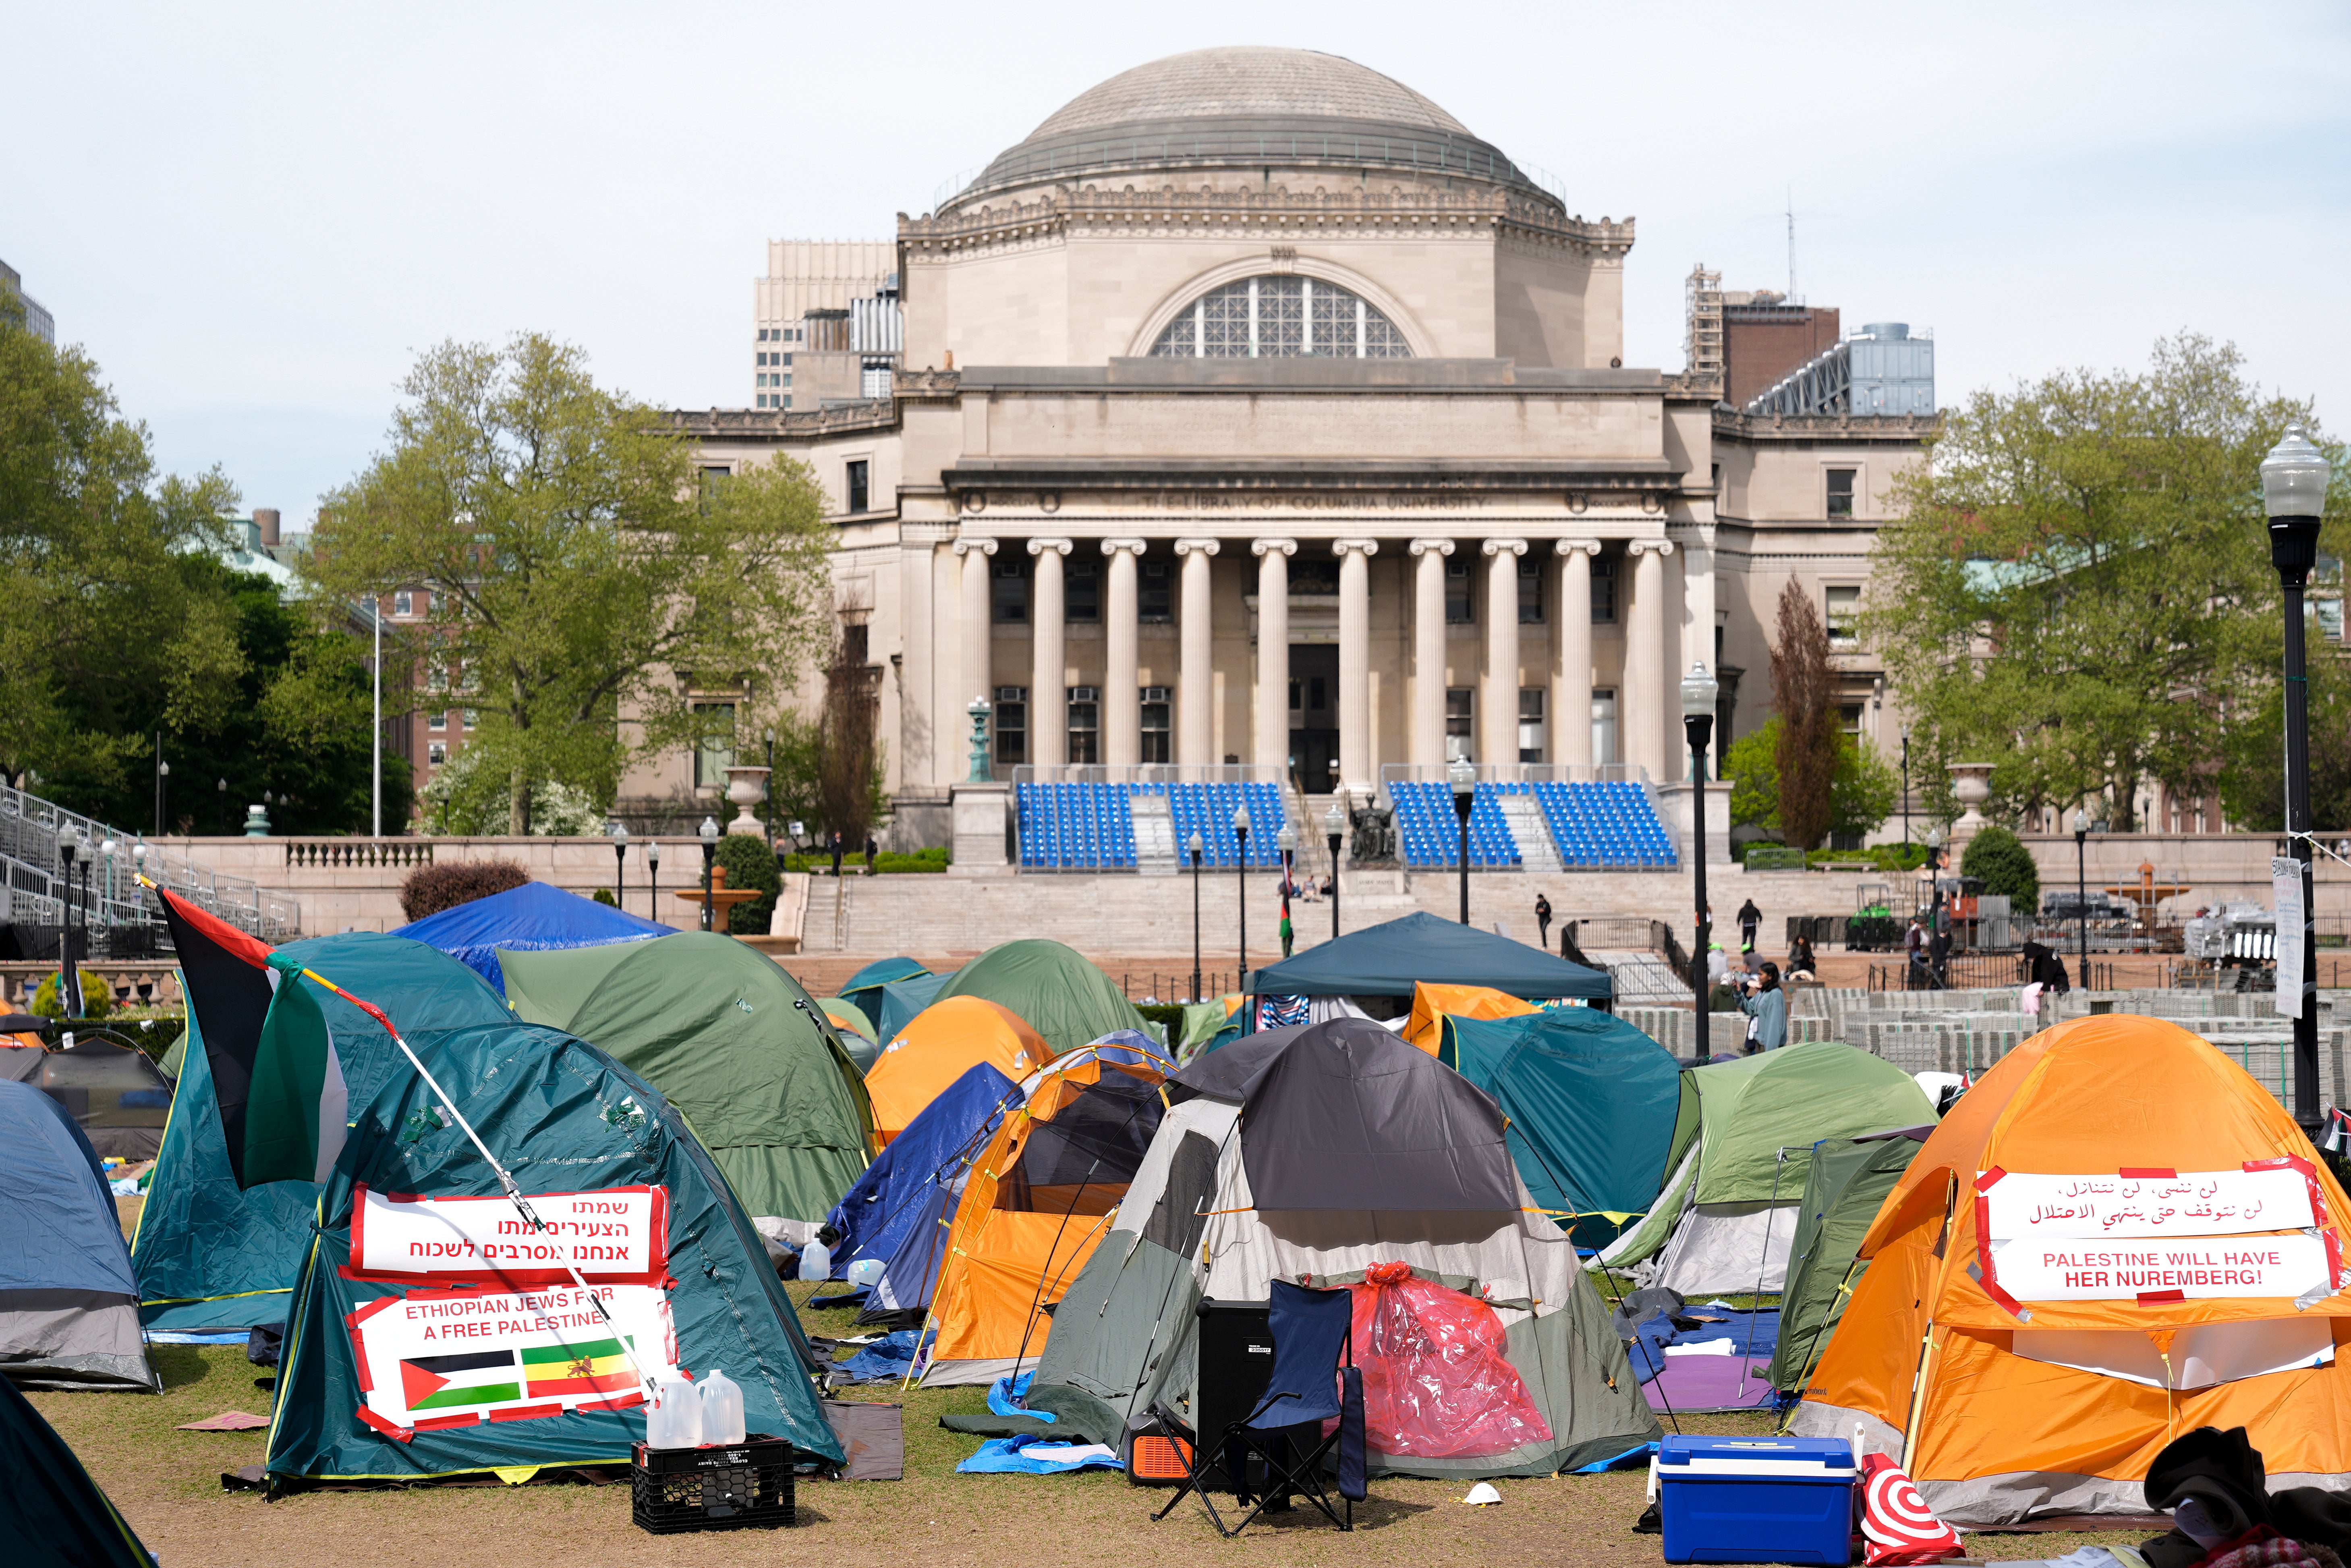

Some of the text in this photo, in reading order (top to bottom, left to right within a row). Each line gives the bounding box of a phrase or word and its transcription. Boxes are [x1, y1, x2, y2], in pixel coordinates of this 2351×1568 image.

[1142, 495, 1174, 509] THE
[1259, 495, 1283, 509] OF
[1290, 495, 1377, 509] COLUMBIA
[1386, 495, 1488, 509] UNIVERSITY
[2272, 860, 2300, 878] STAYING FOCUSED
[2123, 1181, 2140, 1198] لن
[2200, 1181, 2217, 1199] لن
[572, 1202, 628, 1215] שמתו
[2030, 1199, 2262, 1230] لن نتوقف حتى ينتهي الاحتلال
[498, 1220, 628, 1237] הצעירים מתו
[410, 1238, 475, 1257] לשכוח
[573, 1246, 629, 1260] אנחנו
[2044, 1252, 2281, 1267] PALESTINE WILL HAVE
[2065, 1269, 2262, 1287] HER NUREMBERG!
[406, 1298, 509, 1319] ETHIOPIAN
[515, 1292, 569, 1311] JEWS
[424, 1311, 603, 1340] A FREE PALESTINE
